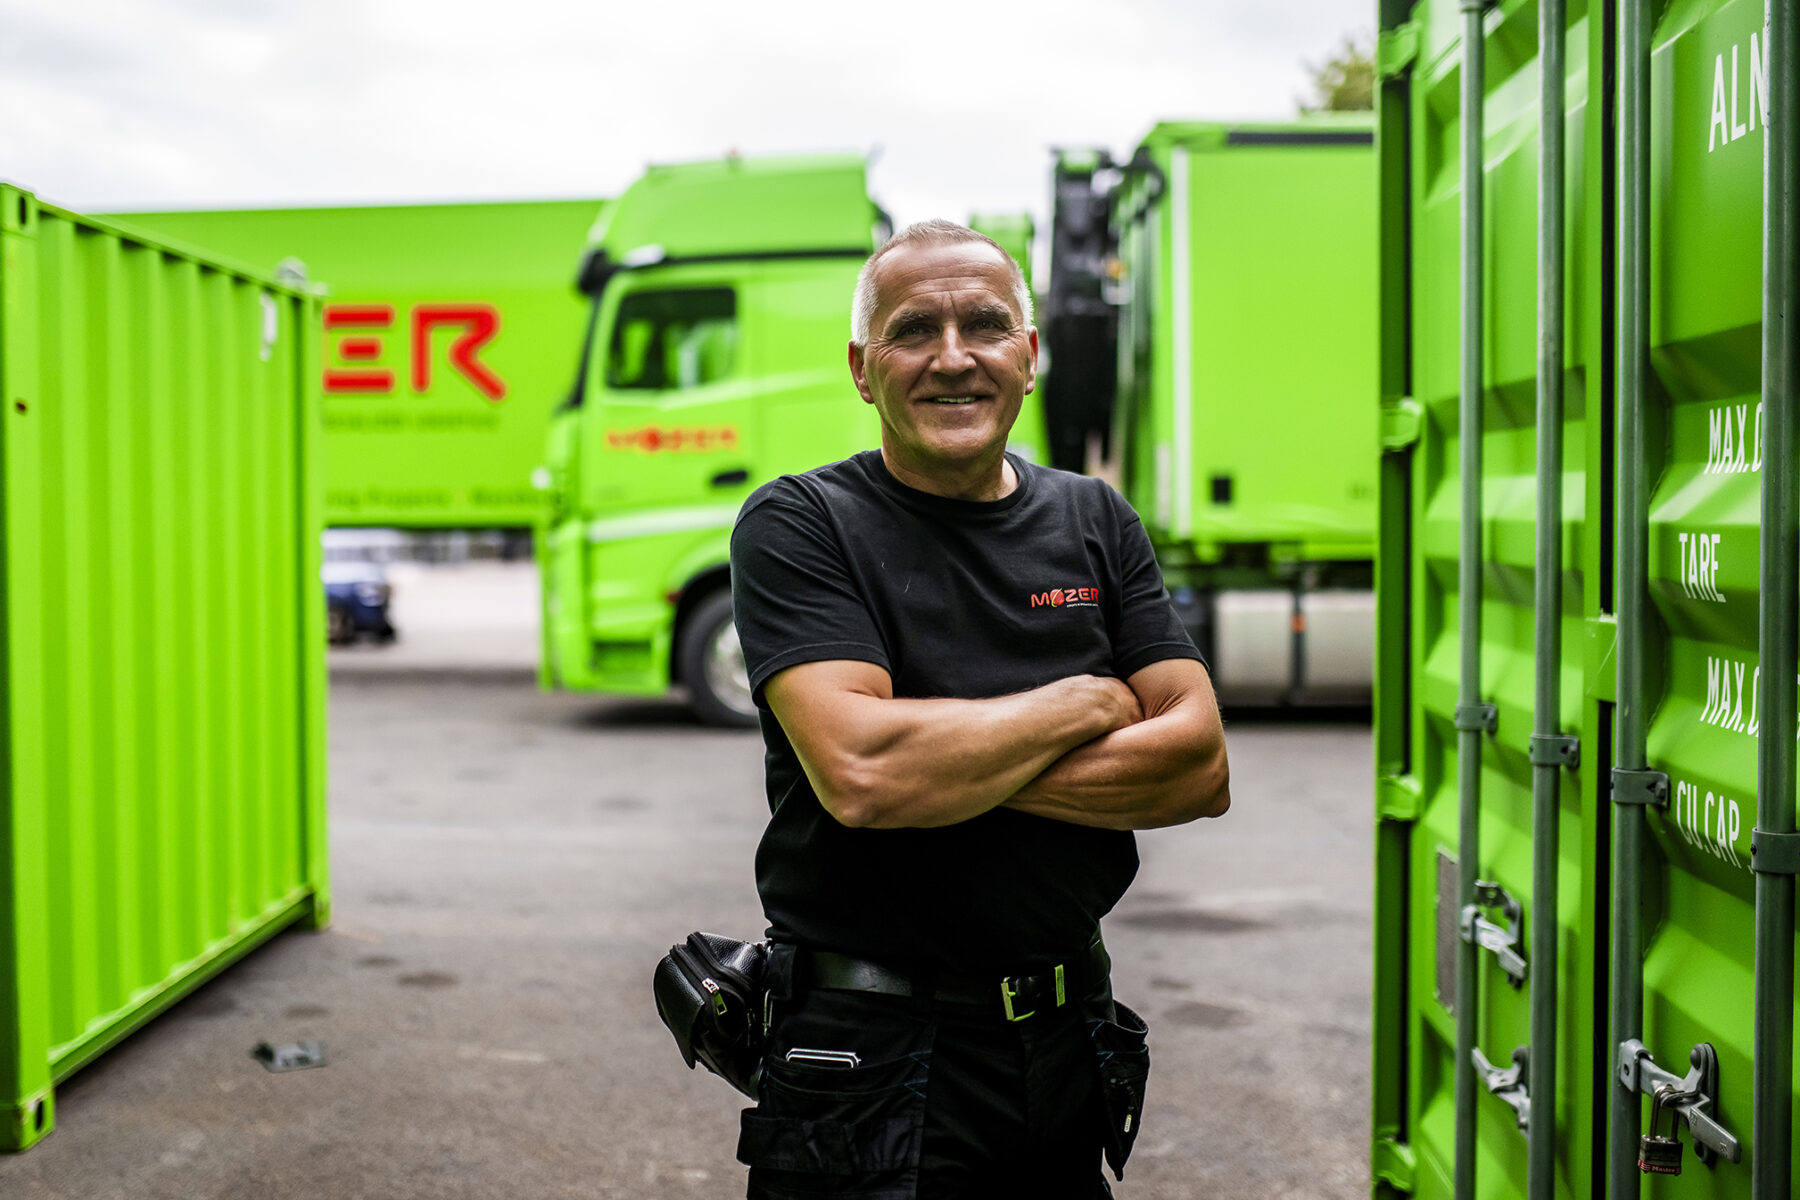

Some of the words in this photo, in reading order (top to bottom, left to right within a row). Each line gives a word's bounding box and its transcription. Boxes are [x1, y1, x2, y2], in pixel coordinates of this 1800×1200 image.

[1031, 587, 1099, 608] MOZER
[1679, 532, 1726, 603] TARE
[1700, 656, 1760, 738] MAX.C
